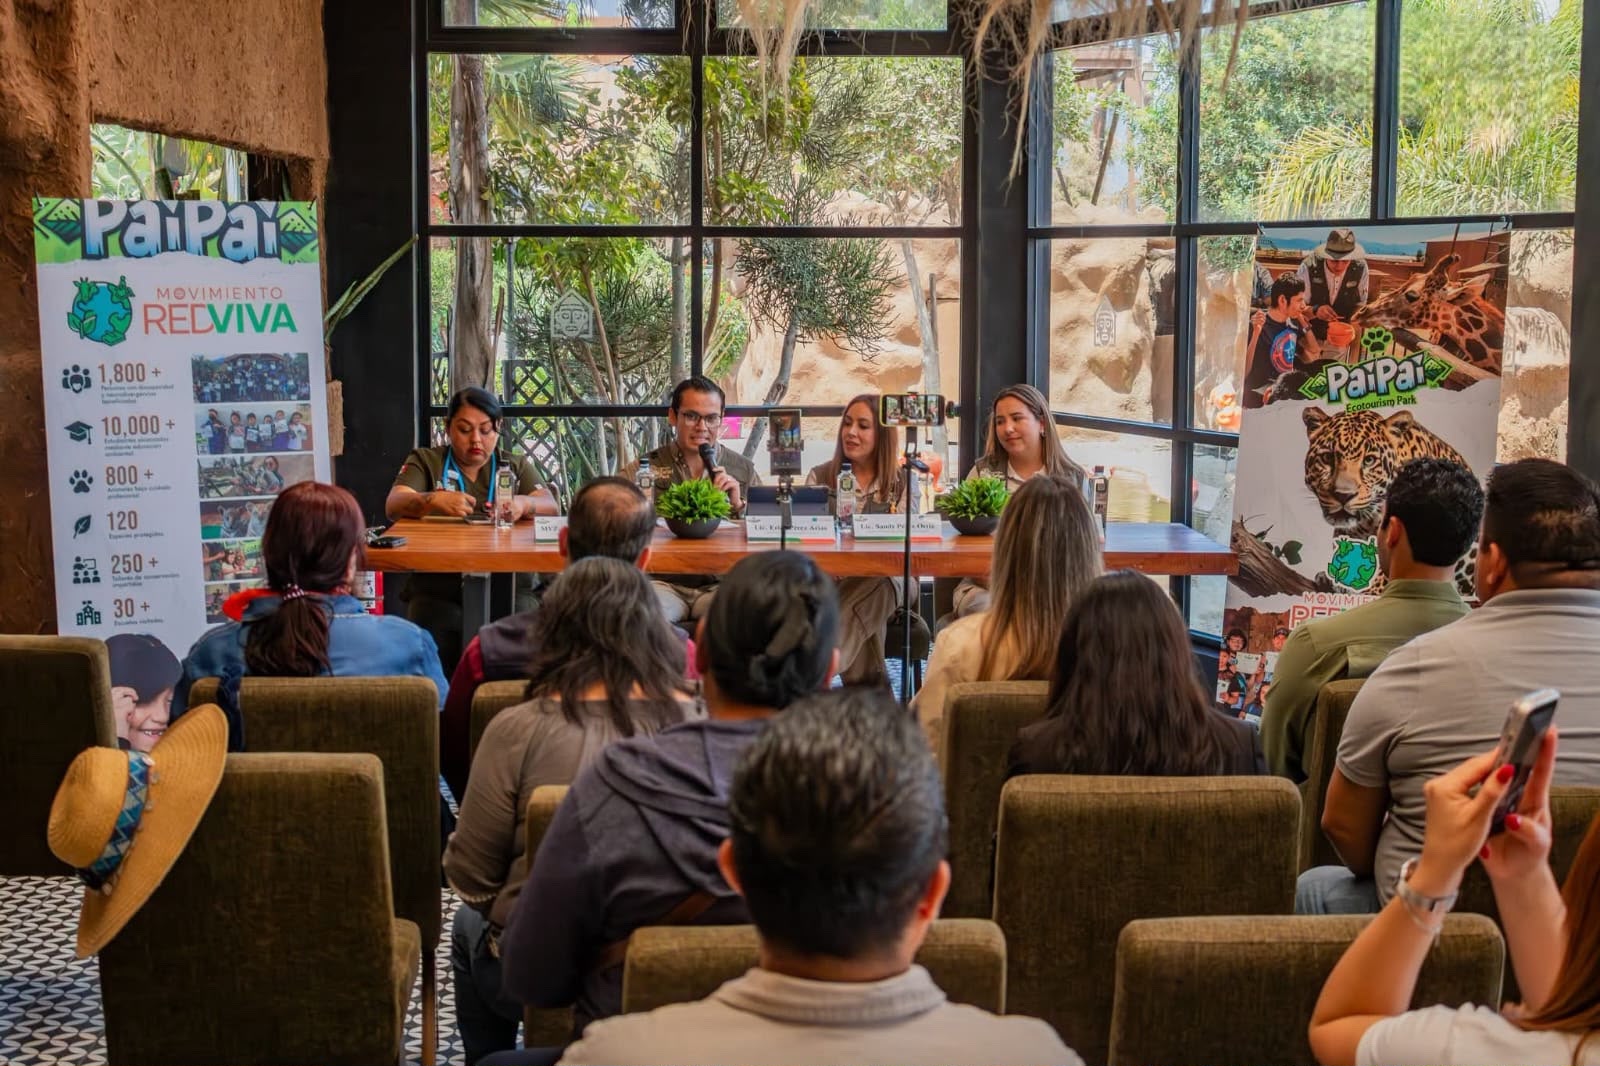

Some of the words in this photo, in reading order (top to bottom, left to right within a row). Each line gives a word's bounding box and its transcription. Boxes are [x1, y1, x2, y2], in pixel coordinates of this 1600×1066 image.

[81, 200, 281, 264] PaiPai
[156, 286, 283, 300] MOVIMIENTO
[143, 303, 298, 335] REDVIVA
[98, 363, 146, 385] 1,800
[1327, 351, 1426, 403] PaiPai
[1346, 398, 1395, 413] Ecotourism
[1397, 395, 1417, 406] Park
[101, 415, 160, 438] 10,000
[106, 465, 138, 486] 800
[106, 510, 138, 531] 120
[111, 553, 143, 574] 250
[113, 598, 135, 618] 30
[1304, 593, 1378, 606] MOVIMIE
